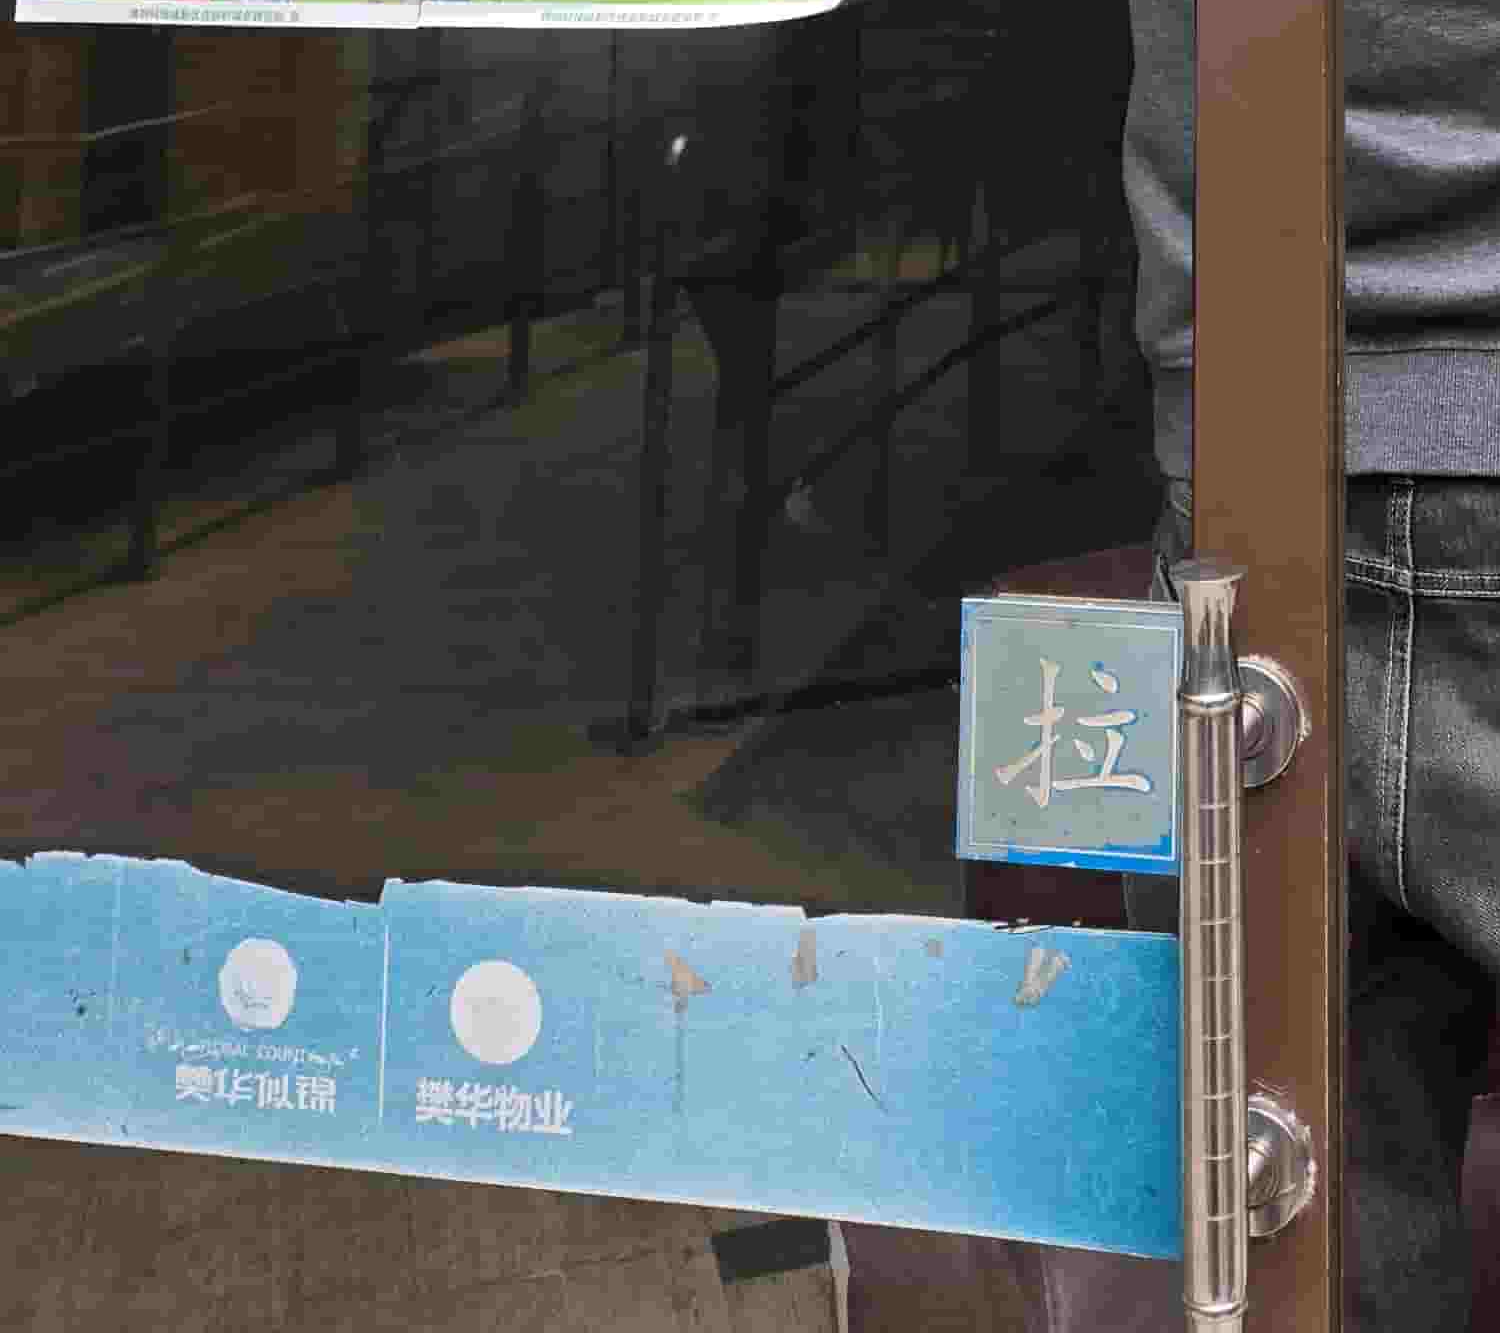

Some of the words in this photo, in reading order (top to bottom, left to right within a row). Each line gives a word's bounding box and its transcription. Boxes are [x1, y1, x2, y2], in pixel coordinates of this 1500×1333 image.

[993, 655, 1152, 807] 拉
[415, 1076, 576, 1135] 樊华物业
